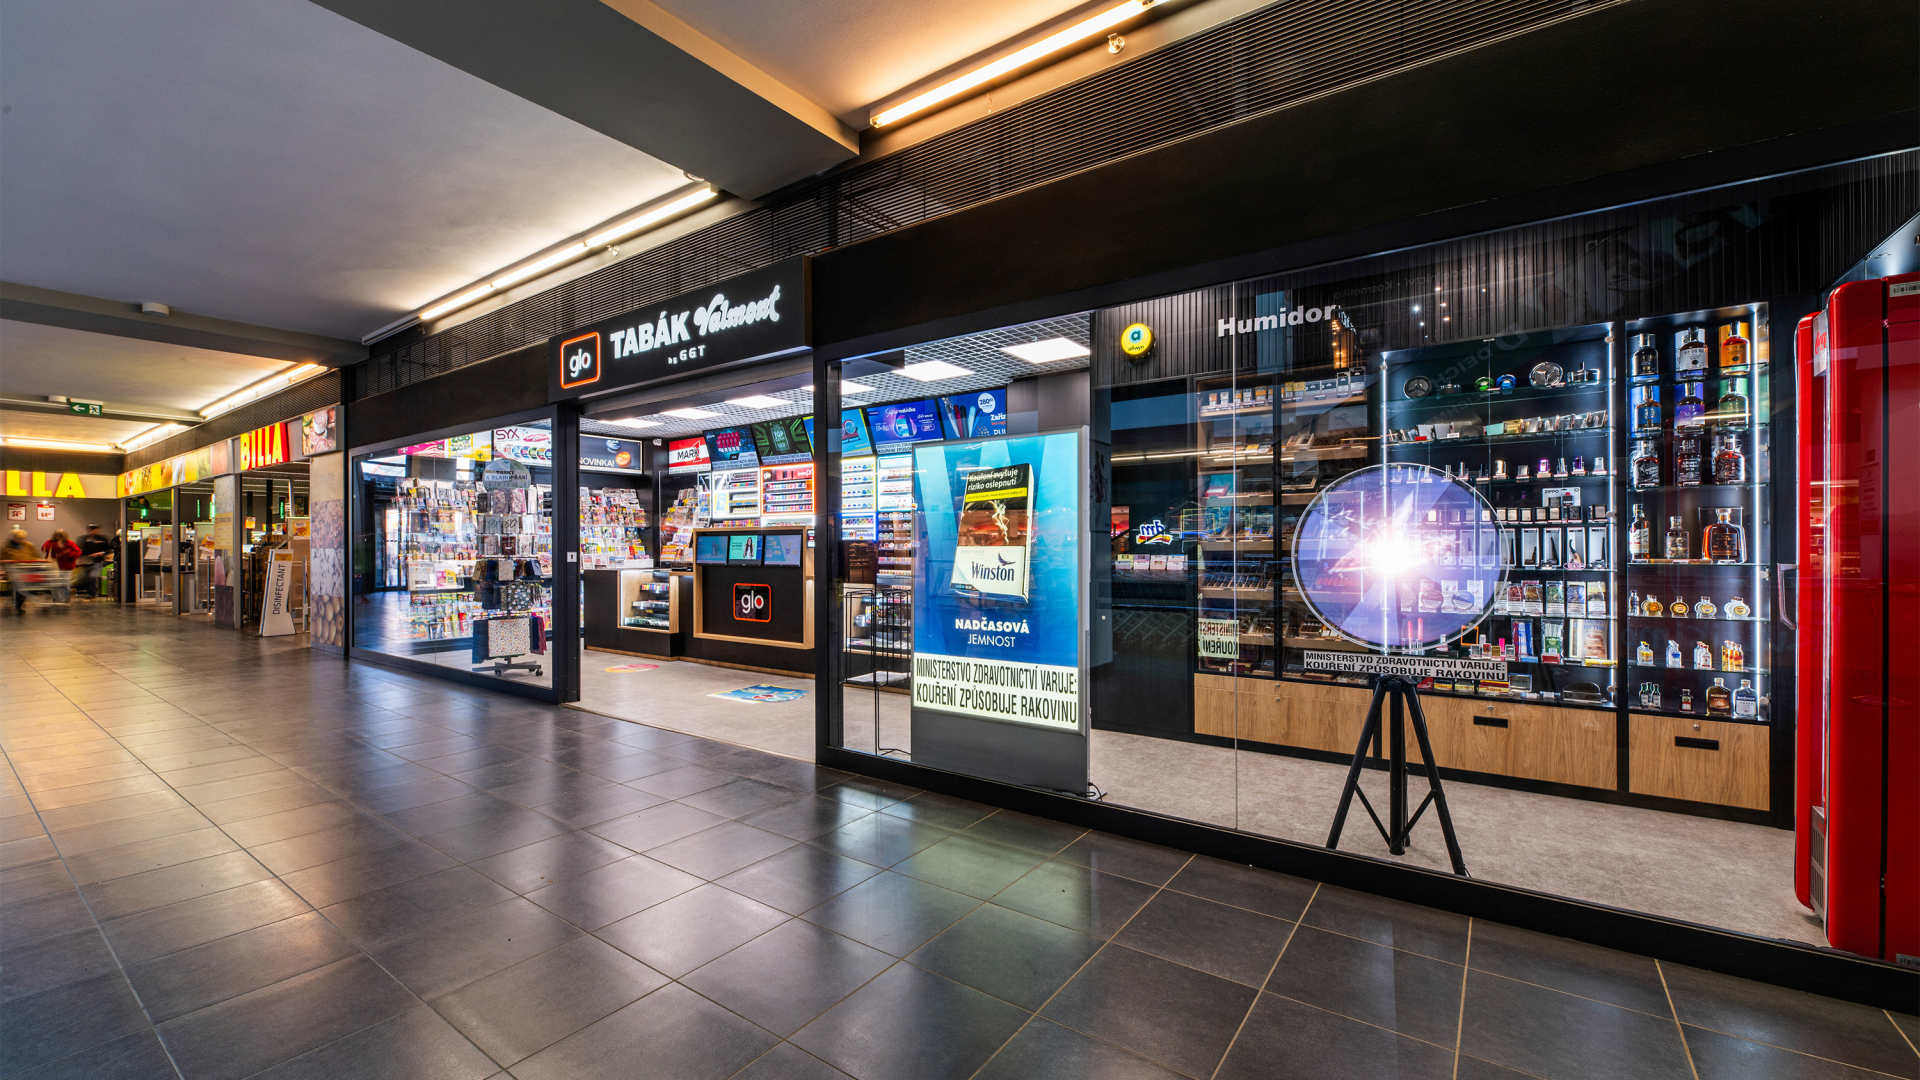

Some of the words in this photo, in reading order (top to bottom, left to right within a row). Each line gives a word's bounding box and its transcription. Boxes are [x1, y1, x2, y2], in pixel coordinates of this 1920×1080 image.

[609, 311, 691, 359] TABÁK
[693, 284, 781, 336] Valmont
[1217, 304, 1337, 338] Humidor
[569, 349, 591, 378] glo
[667, 356, 678, 365] by
[495, 428, 520, 440] SYX
[240, 422, 283, 471] BILLA
[968, 482, 984, 490] riziko
[985, 477, 1017, 489] oslepnutí
[972, 561, 1015, 581] Winston
[272, 564, 286, 615] DISINFECTANT
[741, 590, 764, 613] glo
[955, 617, 1030, 633] NADČASOVÁ
[967, 633, 1016, 648] JEMNOST
[1305, 652, 1373, 664] MINISTERSTVO
[1375, 656, 1457, 668] ZDRAVOTNICTVÍ
[1460, 661, 1505, 672] VARUJE:
[1305, 660, 1355, 671] KOUŘENÍ
[1358, 664, 1431, 677] ZPŮSOBUJE
[1436, 669, 1505, 681] RAKOVINU
[916, 657, 971, 683] MINISTERSTVO
[973, 663, 1038, 690] ZDRAVOTNICTVÍ
[1040, 670, 1077, 695] VARUJE:
[916, 682, 957, 707] KOUŘENÍ
[959, 684, 1017, 715] ZPŮSOBUJE
[1021, 696, 1077, 724] RAKOVINU
